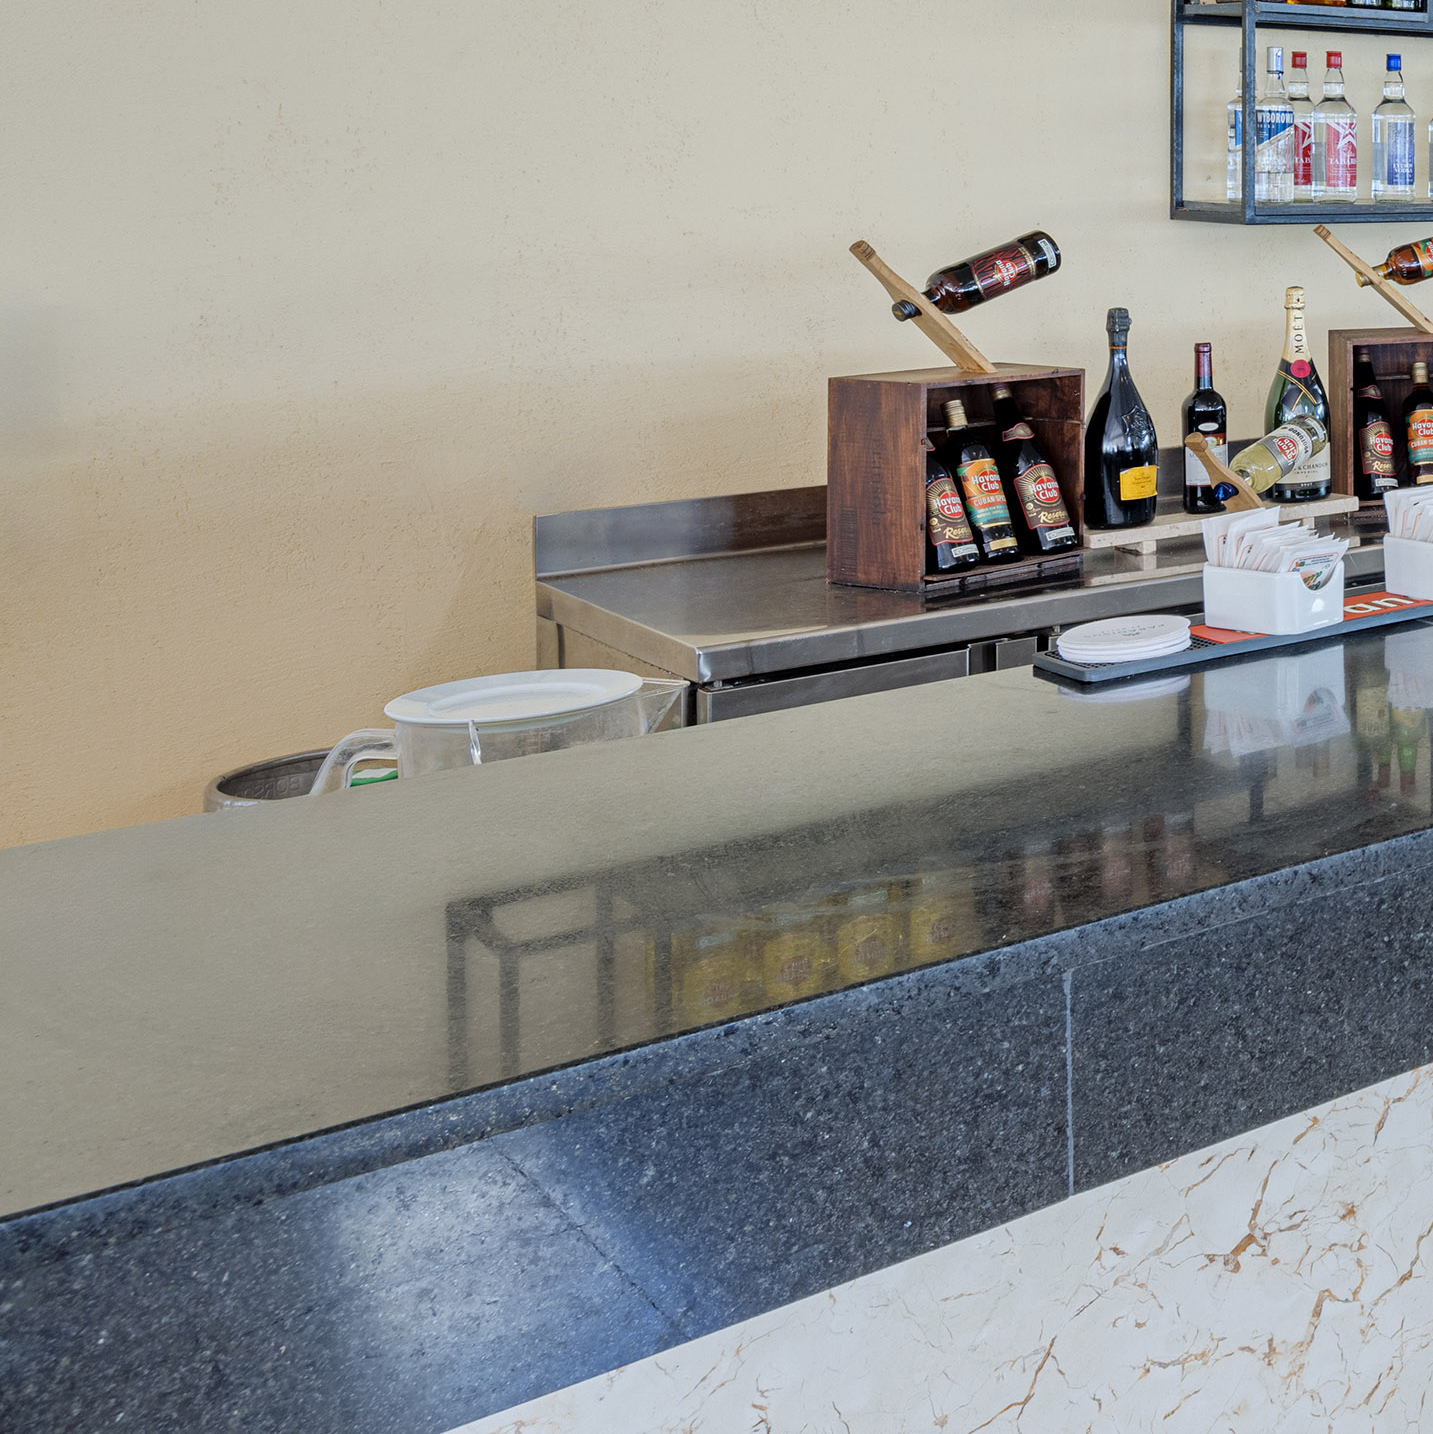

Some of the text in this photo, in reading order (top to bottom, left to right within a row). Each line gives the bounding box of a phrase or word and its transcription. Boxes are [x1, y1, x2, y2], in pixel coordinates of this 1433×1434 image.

[994, 259, 1011, 287] Havana
[1005, 261, 1016, 279] Club
[1284, 436, 1297, 458] Club
[1369, 436, 1394, 446] Havana
[1410, 439, 1428, 449] CUBAN
[1272, 437, 1294, 466] Havana
[1376, 443, 1392, 452] Club
[970, 474, 1000, 485] Havana
[981, 481, 1000, 492] Club
[1029, 480, 1060, 493] Havana
[1039, 489, 1058, 501] Club
[932, 496, 962, 509] Havana
[973, 496, 995, 507] CUBAN
[943, 504, 962, 516] Club
